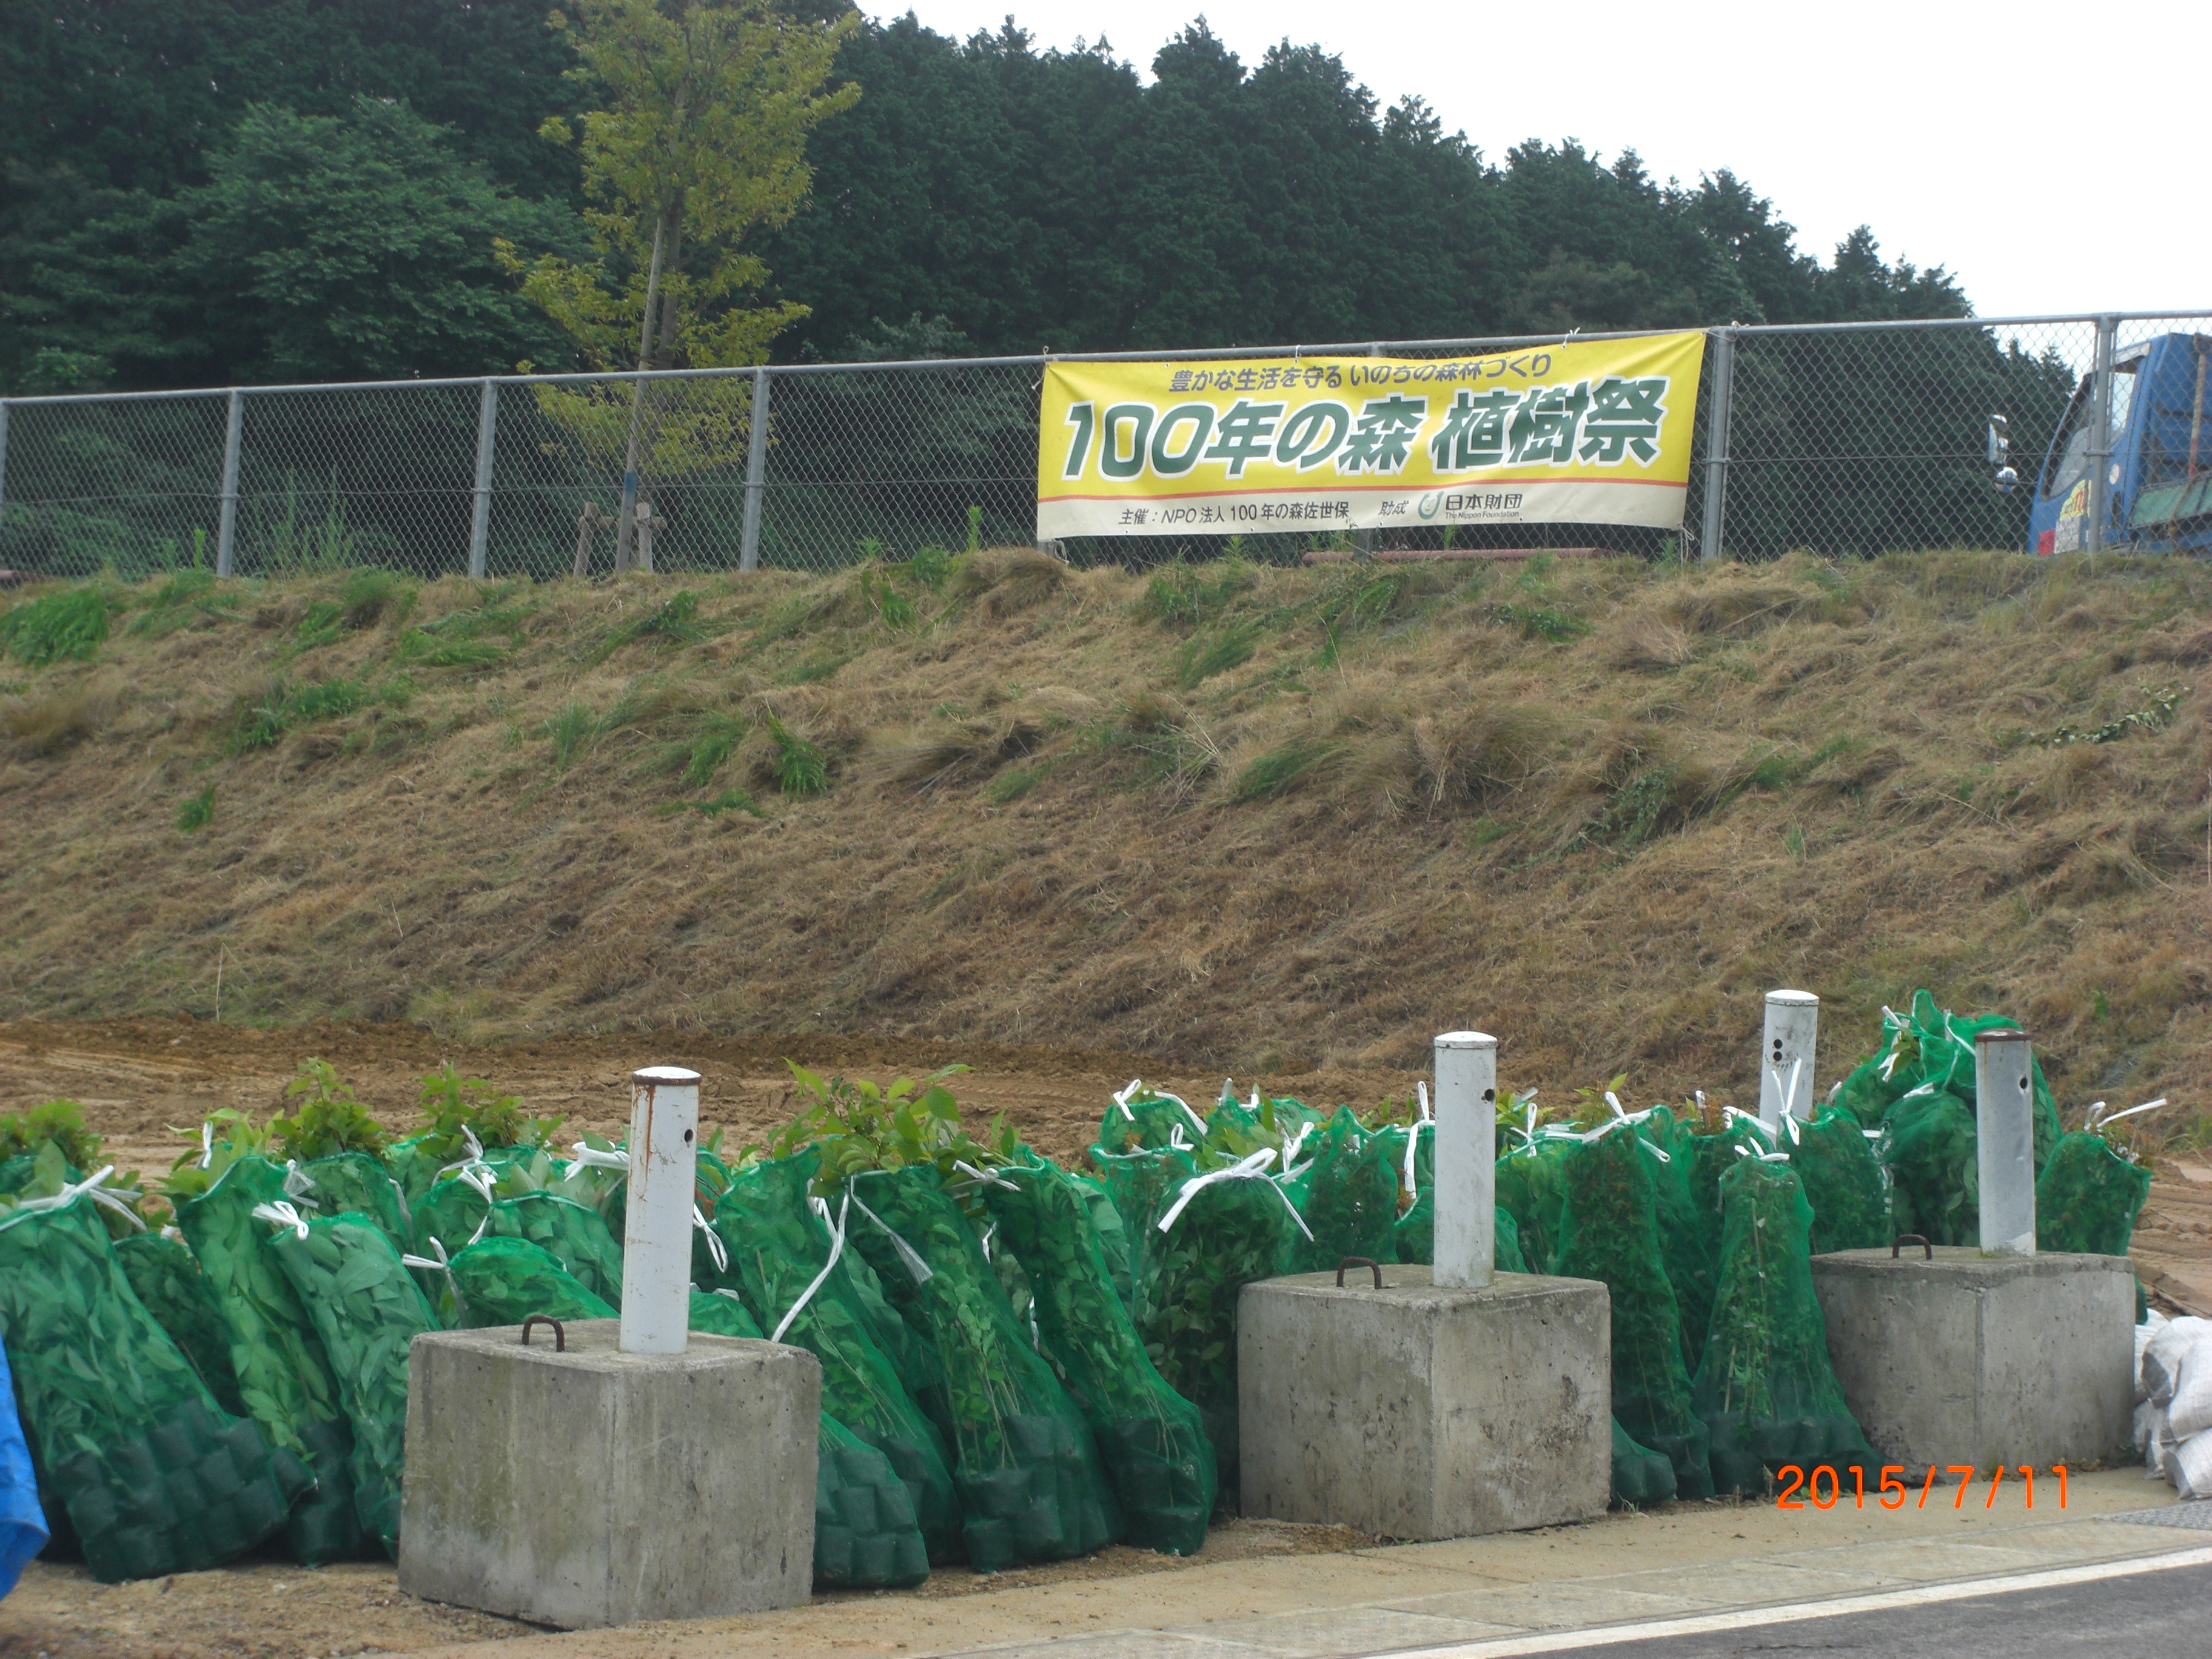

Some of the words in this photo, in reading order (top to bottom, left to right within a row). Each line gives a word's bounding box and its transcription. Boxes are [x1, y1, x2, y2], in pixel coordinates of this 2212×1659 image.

[1168, 366, 1343, 393] 豊かな生活を守る
[1350, 353, 1552, 386] いのちの森林づくり
[1062, 392, 1427, 480] 100年の森
[1430, 375, 1669, 474] 植樹祭
[1378, 500, 1409, 516] 助成
[1445, 493, 1523, 511] 日本財団
[1458, 511, 1482, 521] Nippon
